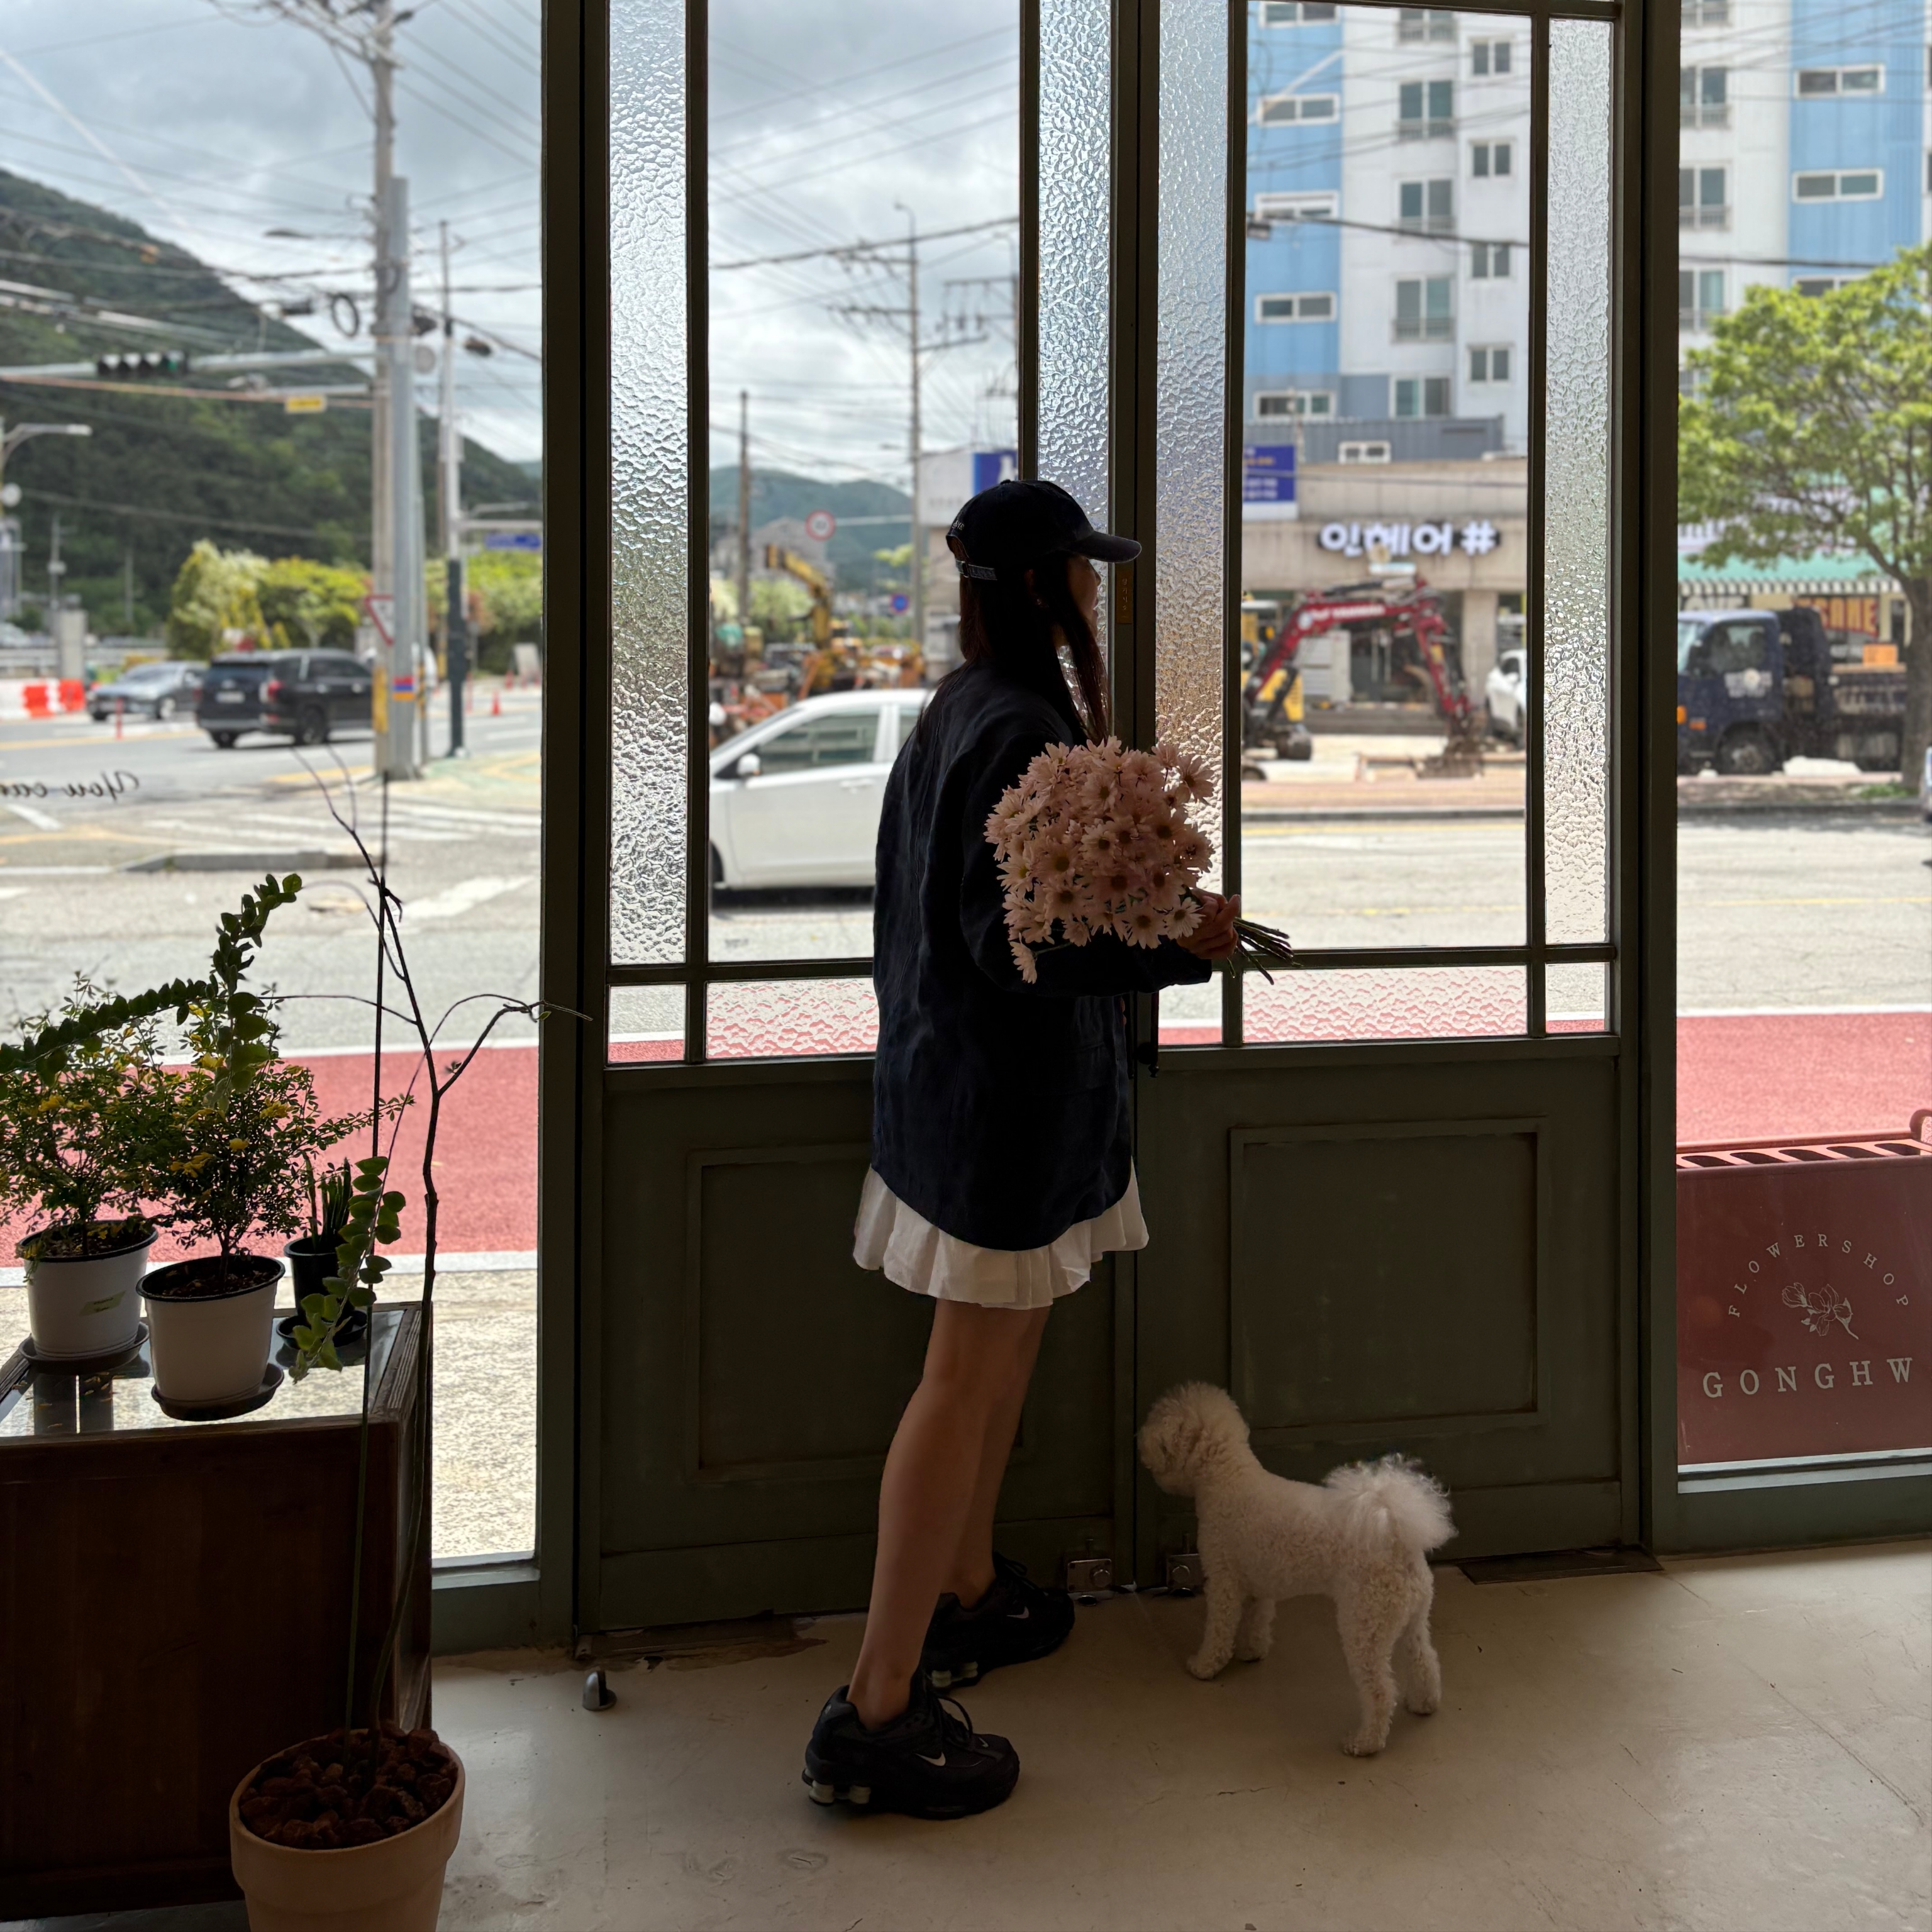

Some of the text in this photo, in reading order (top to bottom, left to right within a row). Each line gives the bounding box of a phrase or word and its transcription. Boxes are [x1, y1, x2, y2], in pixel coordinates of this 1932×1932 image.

[1320, 521, 1453, 557] 인헤어
[1728, 1233, 1909, 1318] FLOWERSHOP
[1702, 1357, 1913, 1398] GONGHW
